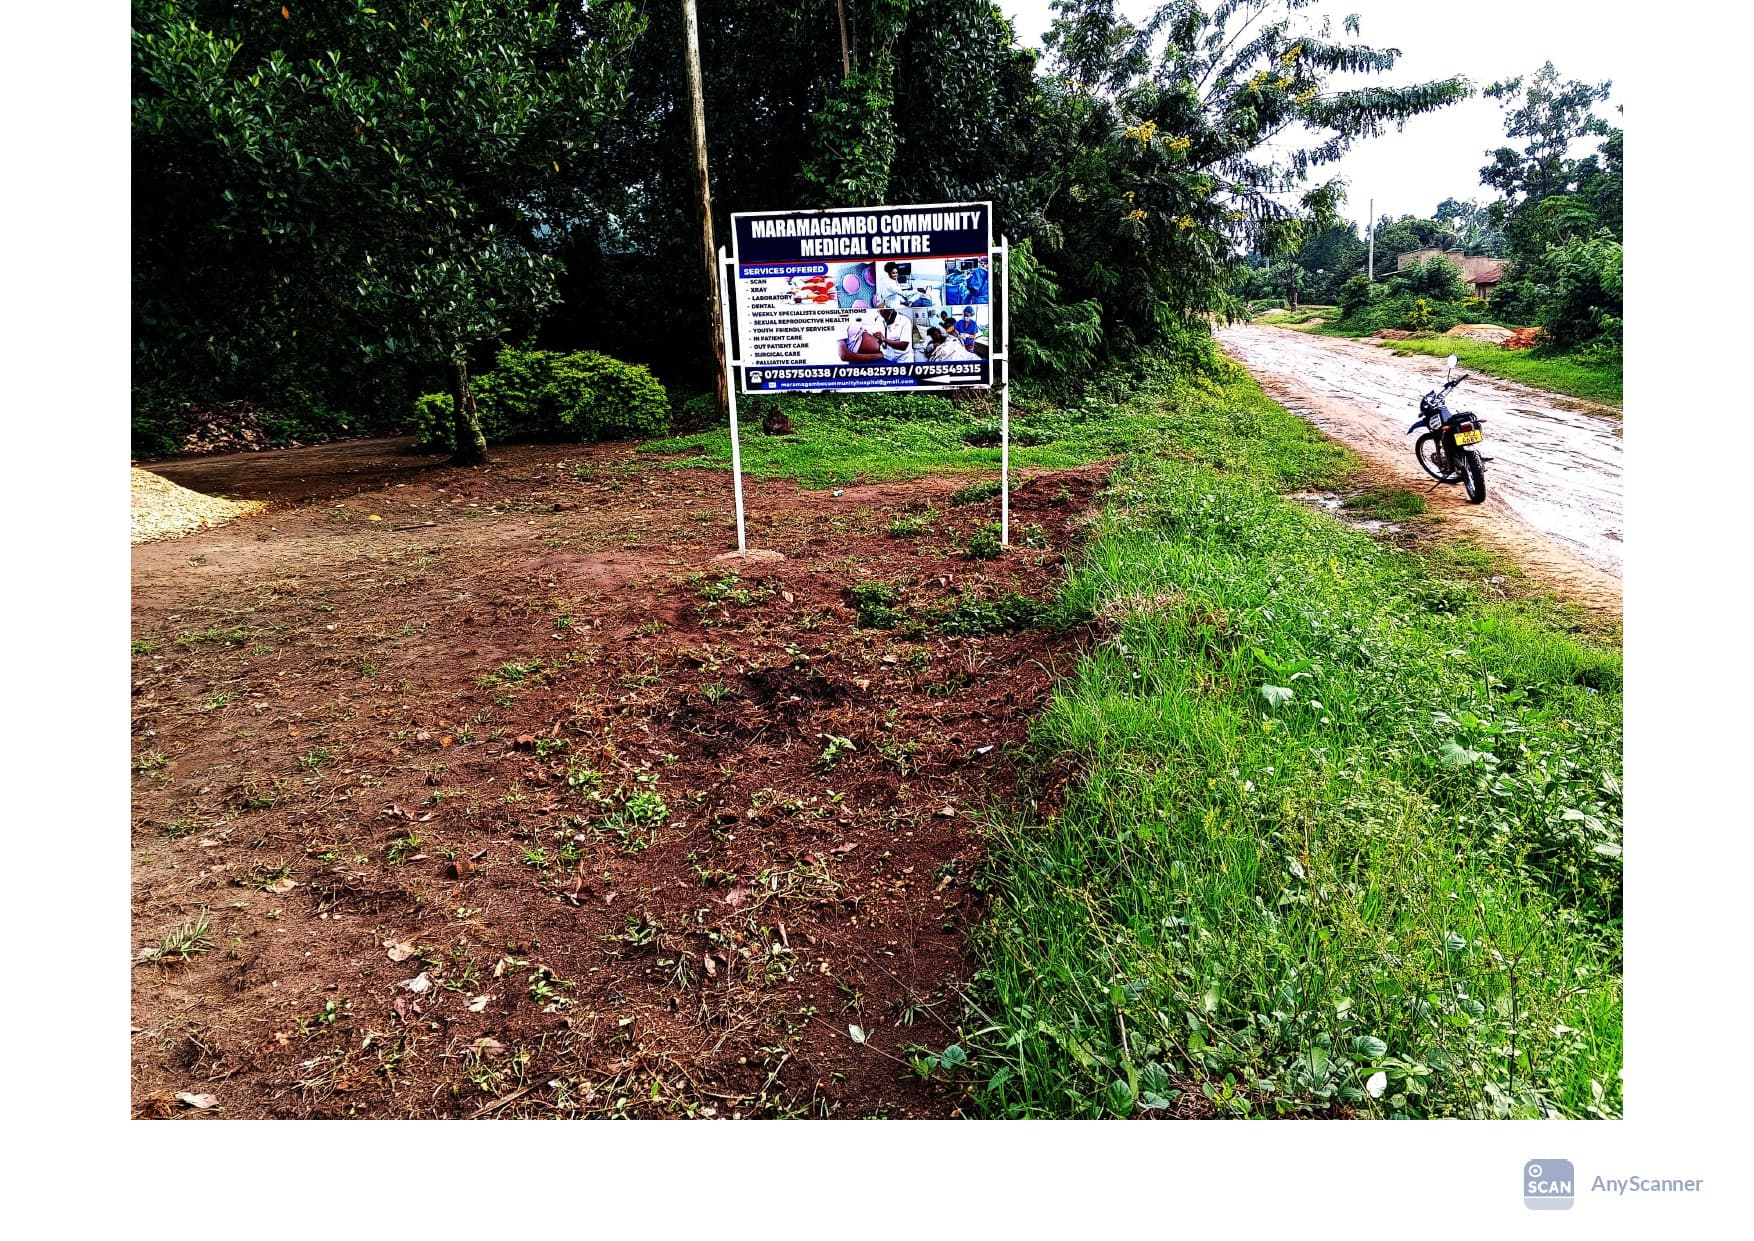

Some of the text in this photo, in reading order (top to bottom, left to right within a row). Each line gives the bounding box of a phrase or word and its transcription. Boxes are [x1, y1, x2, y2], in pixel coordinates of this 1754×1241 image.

[751, 211, 981, 238] MARAMAGAMBO COMMUNITY
[801, 235, 930, 257] MEDICAL CENTRE
[744, 265, 824, 275] SERVICES OFFERED
[764, 368, 831, 379] 0785750338
[838, 366, 907, 377] 0784825798
[914, 364, 981, 375] 0755549315
